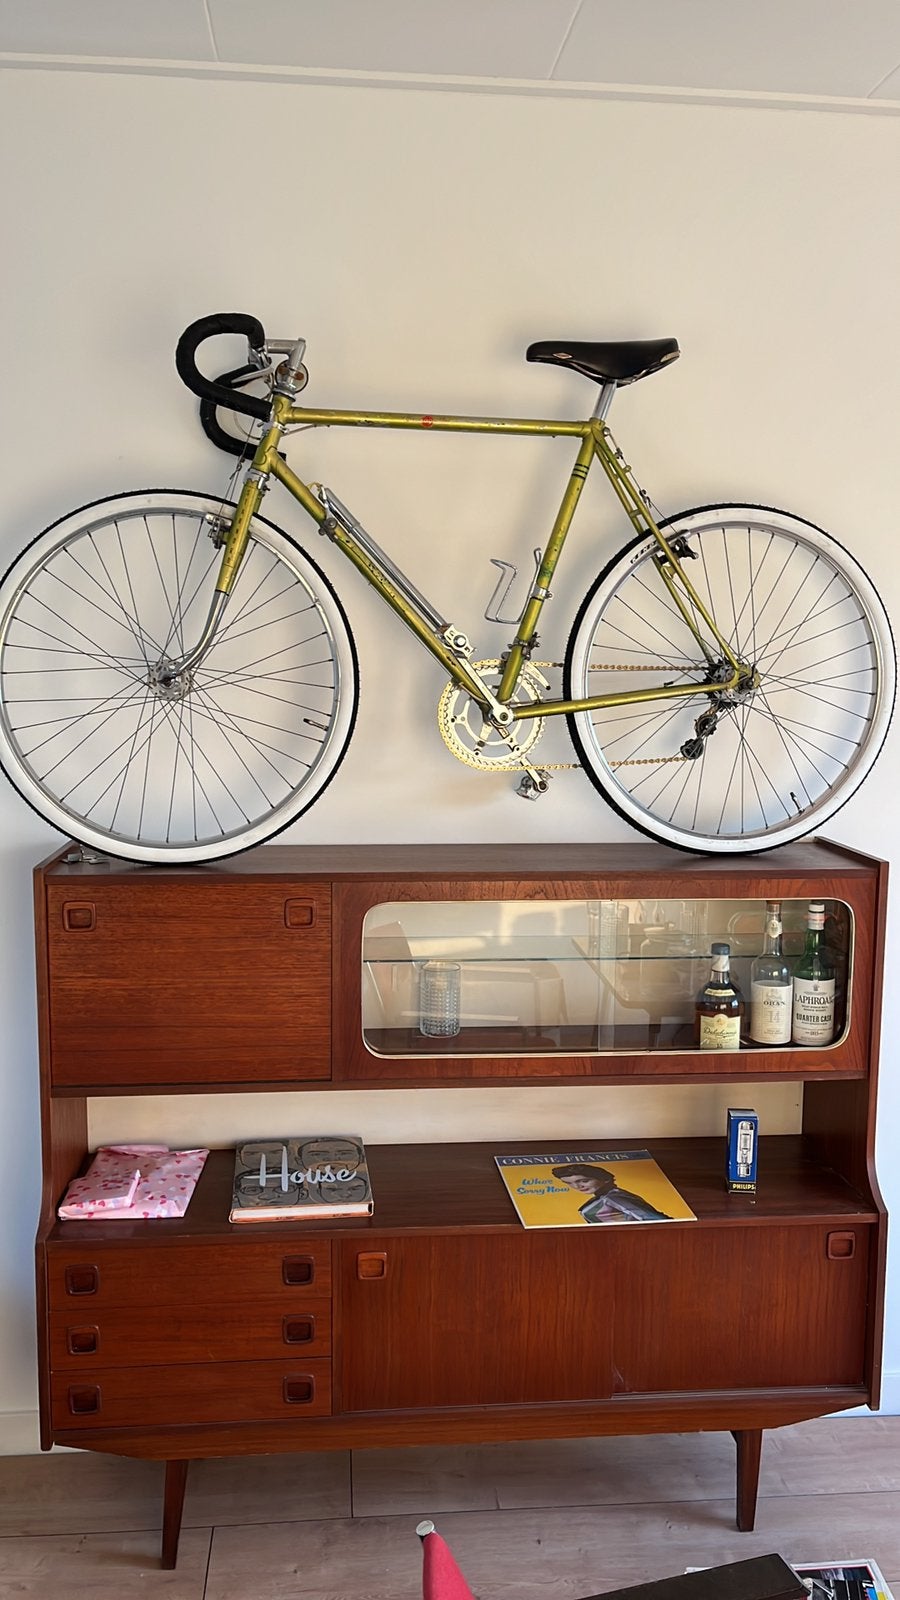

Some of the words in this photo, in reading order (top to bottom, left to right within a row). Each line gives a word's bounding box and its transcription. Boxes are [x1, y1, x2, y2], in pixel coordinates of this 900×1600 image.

[796, 1013, 820, 1022] QUARTER
[502, 1157, 560, 1165] CONNIE
[565, 1153, 629, 1162] FRANCIS
[243, 1145, 357, 1192] House
